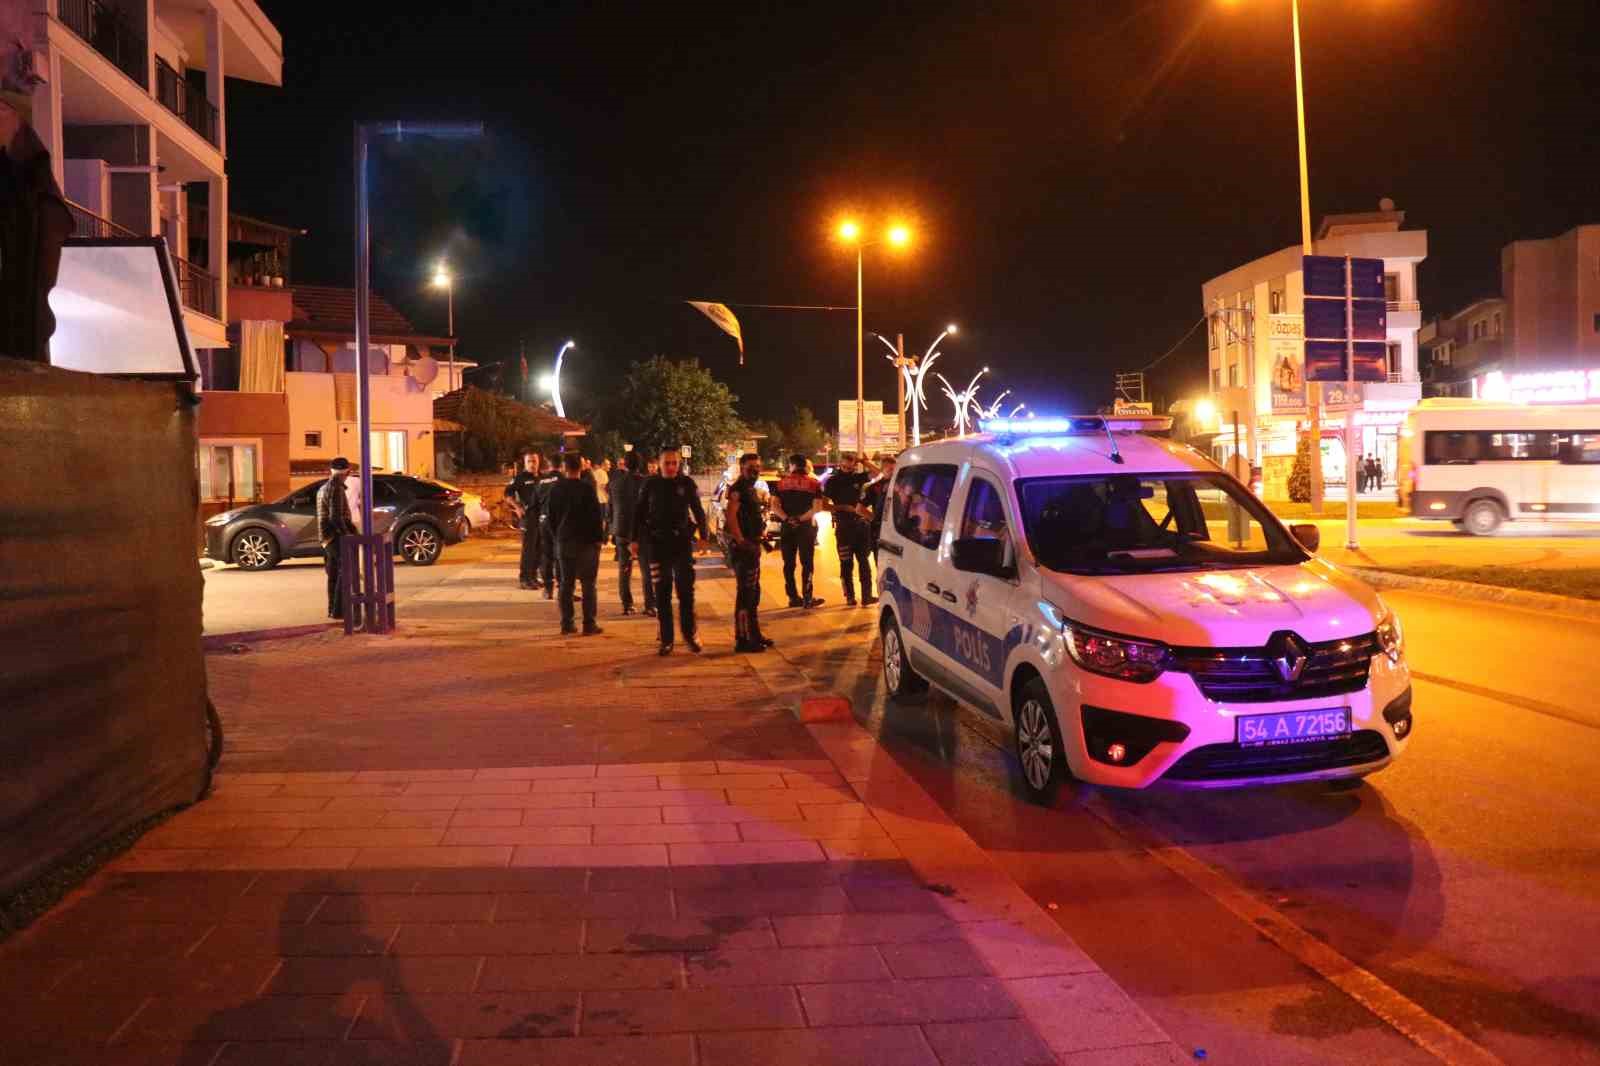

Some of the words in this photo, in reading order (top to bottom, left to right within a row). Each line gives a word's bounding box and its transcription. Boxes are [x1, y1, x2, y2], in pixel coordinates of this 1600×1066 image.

[953, 624, 991, 672] POLİS
[1244, 719, 1268, 740] 54
[1274, 717, 1289, 737] A
[1296, 712, 1346, 737] 72156
